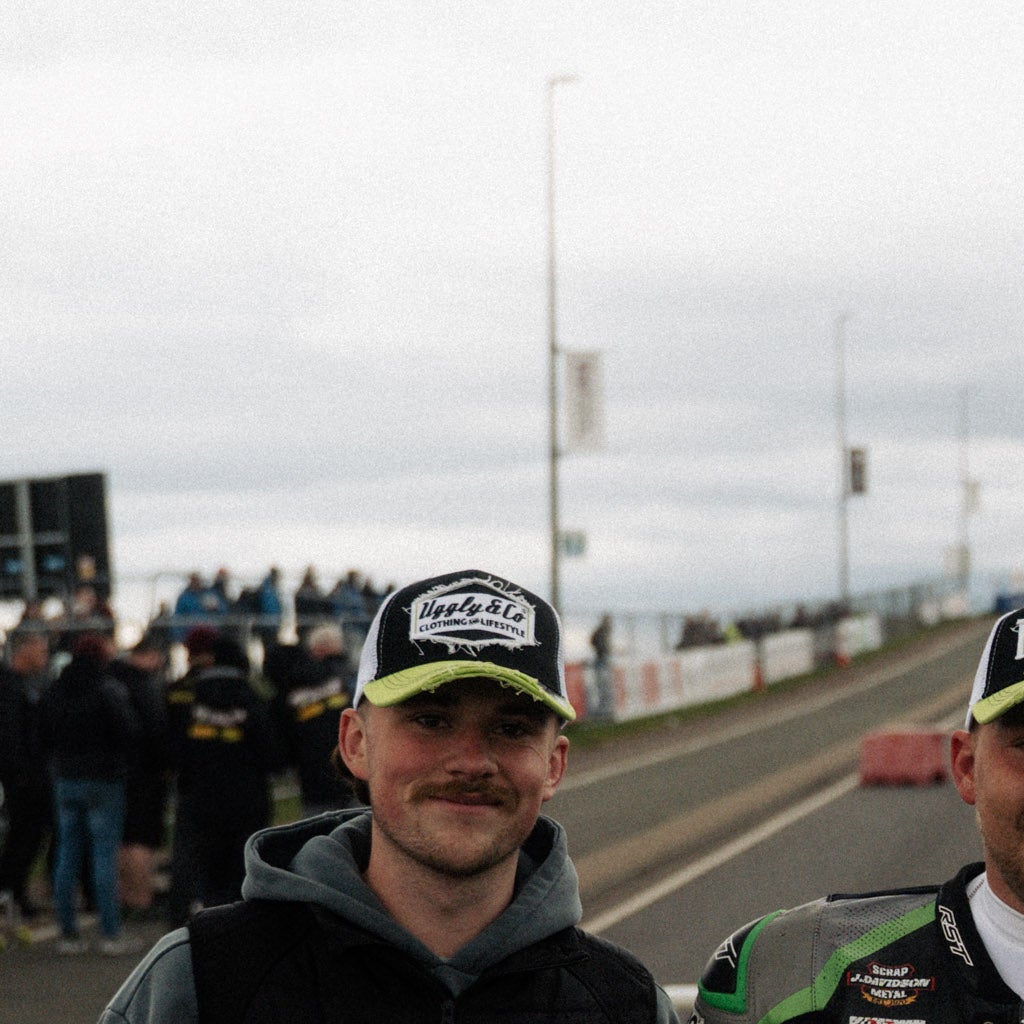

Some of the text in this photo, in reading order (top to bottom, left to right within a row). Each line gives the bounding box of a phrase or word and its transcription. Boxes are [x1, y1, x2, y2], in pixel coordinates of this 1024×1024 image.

[419, 618, 467, 632] CLOTHING
[480, 618, 526, 638] LIFESTYLE
[938, 904, 974, 967] RST
[872, 964, 909, 976] SCRAP
[870, 988, 908, 999] METAL
